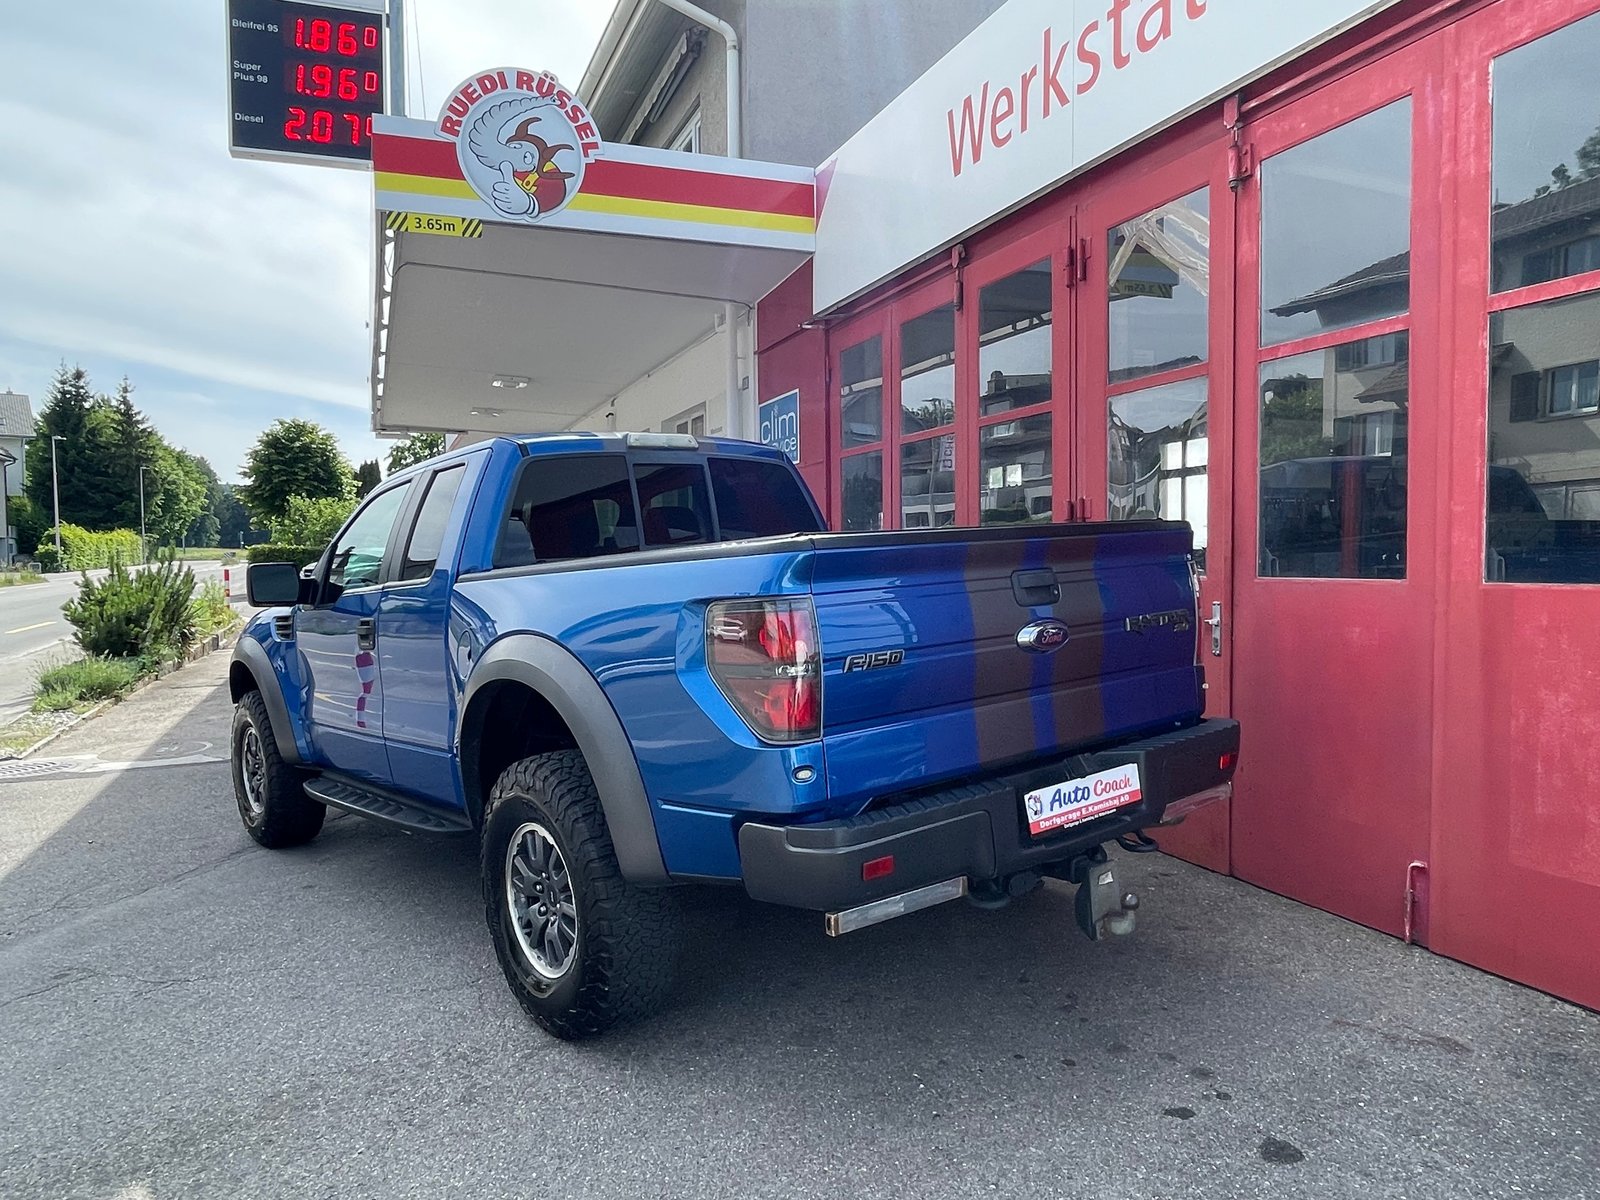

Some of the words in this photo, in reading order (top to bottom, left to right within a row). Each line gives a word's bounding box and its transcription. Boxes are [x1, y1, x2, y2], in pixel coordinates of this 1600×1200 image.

[232, 18, 265, 31] Bleifrei
[267, 23, 279, 33] 95
[233, 60, 262, 72] Super
[233, 71, 255, 82] Plus
[256, 73, 269, 84] 98
[947, 0, 1206, 177] Werksta
[234, 112, 264, 124] Diesel
[440, 71, 509, 138] RUEDI
[515, 70, 600, 158] RÜSSEL
[414, 217, 456, 232] 3.65m
[761, 409, 797, 445] clim
[1041, 628, 1063, 644] Ford
[1049, 785, 1091, 812] Auto
[1093, 773, 1133, 797] Coach
[1039, 810, 1081, 829] Dorfgarage
